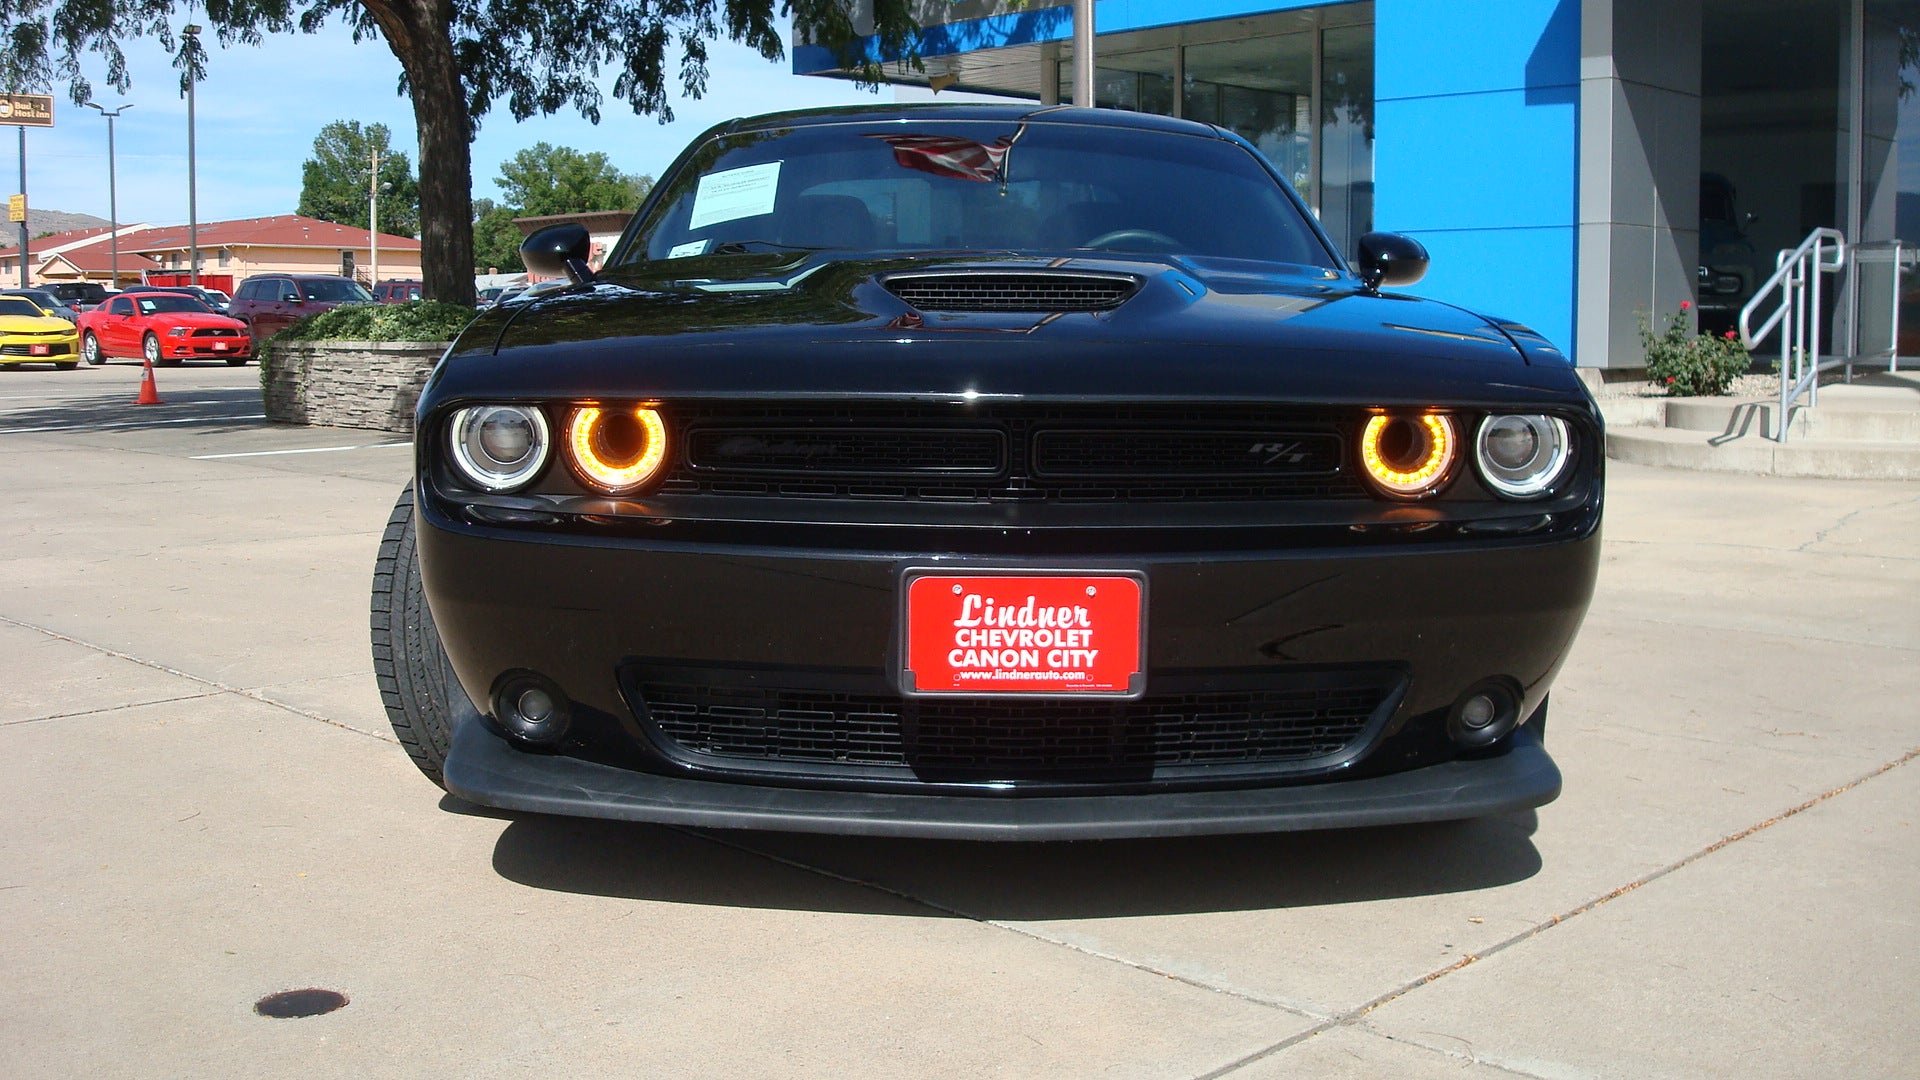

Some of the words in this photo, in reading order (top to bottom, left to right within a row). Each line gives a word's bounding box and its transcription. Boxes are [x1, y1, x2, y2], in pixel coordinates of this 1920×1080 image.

[14, 101, 45, 111] Budt
[14, 110, 35, 118] Host
[953, 594, 1091, 628] Lindner
[955, 629, 1093, 648] CHEVROLET
[948, 649, 1039, 668] CANON
[1047, 649, 1099, 668] CITY
[960, 668, 1085, 681] www.lindnerauto.com
